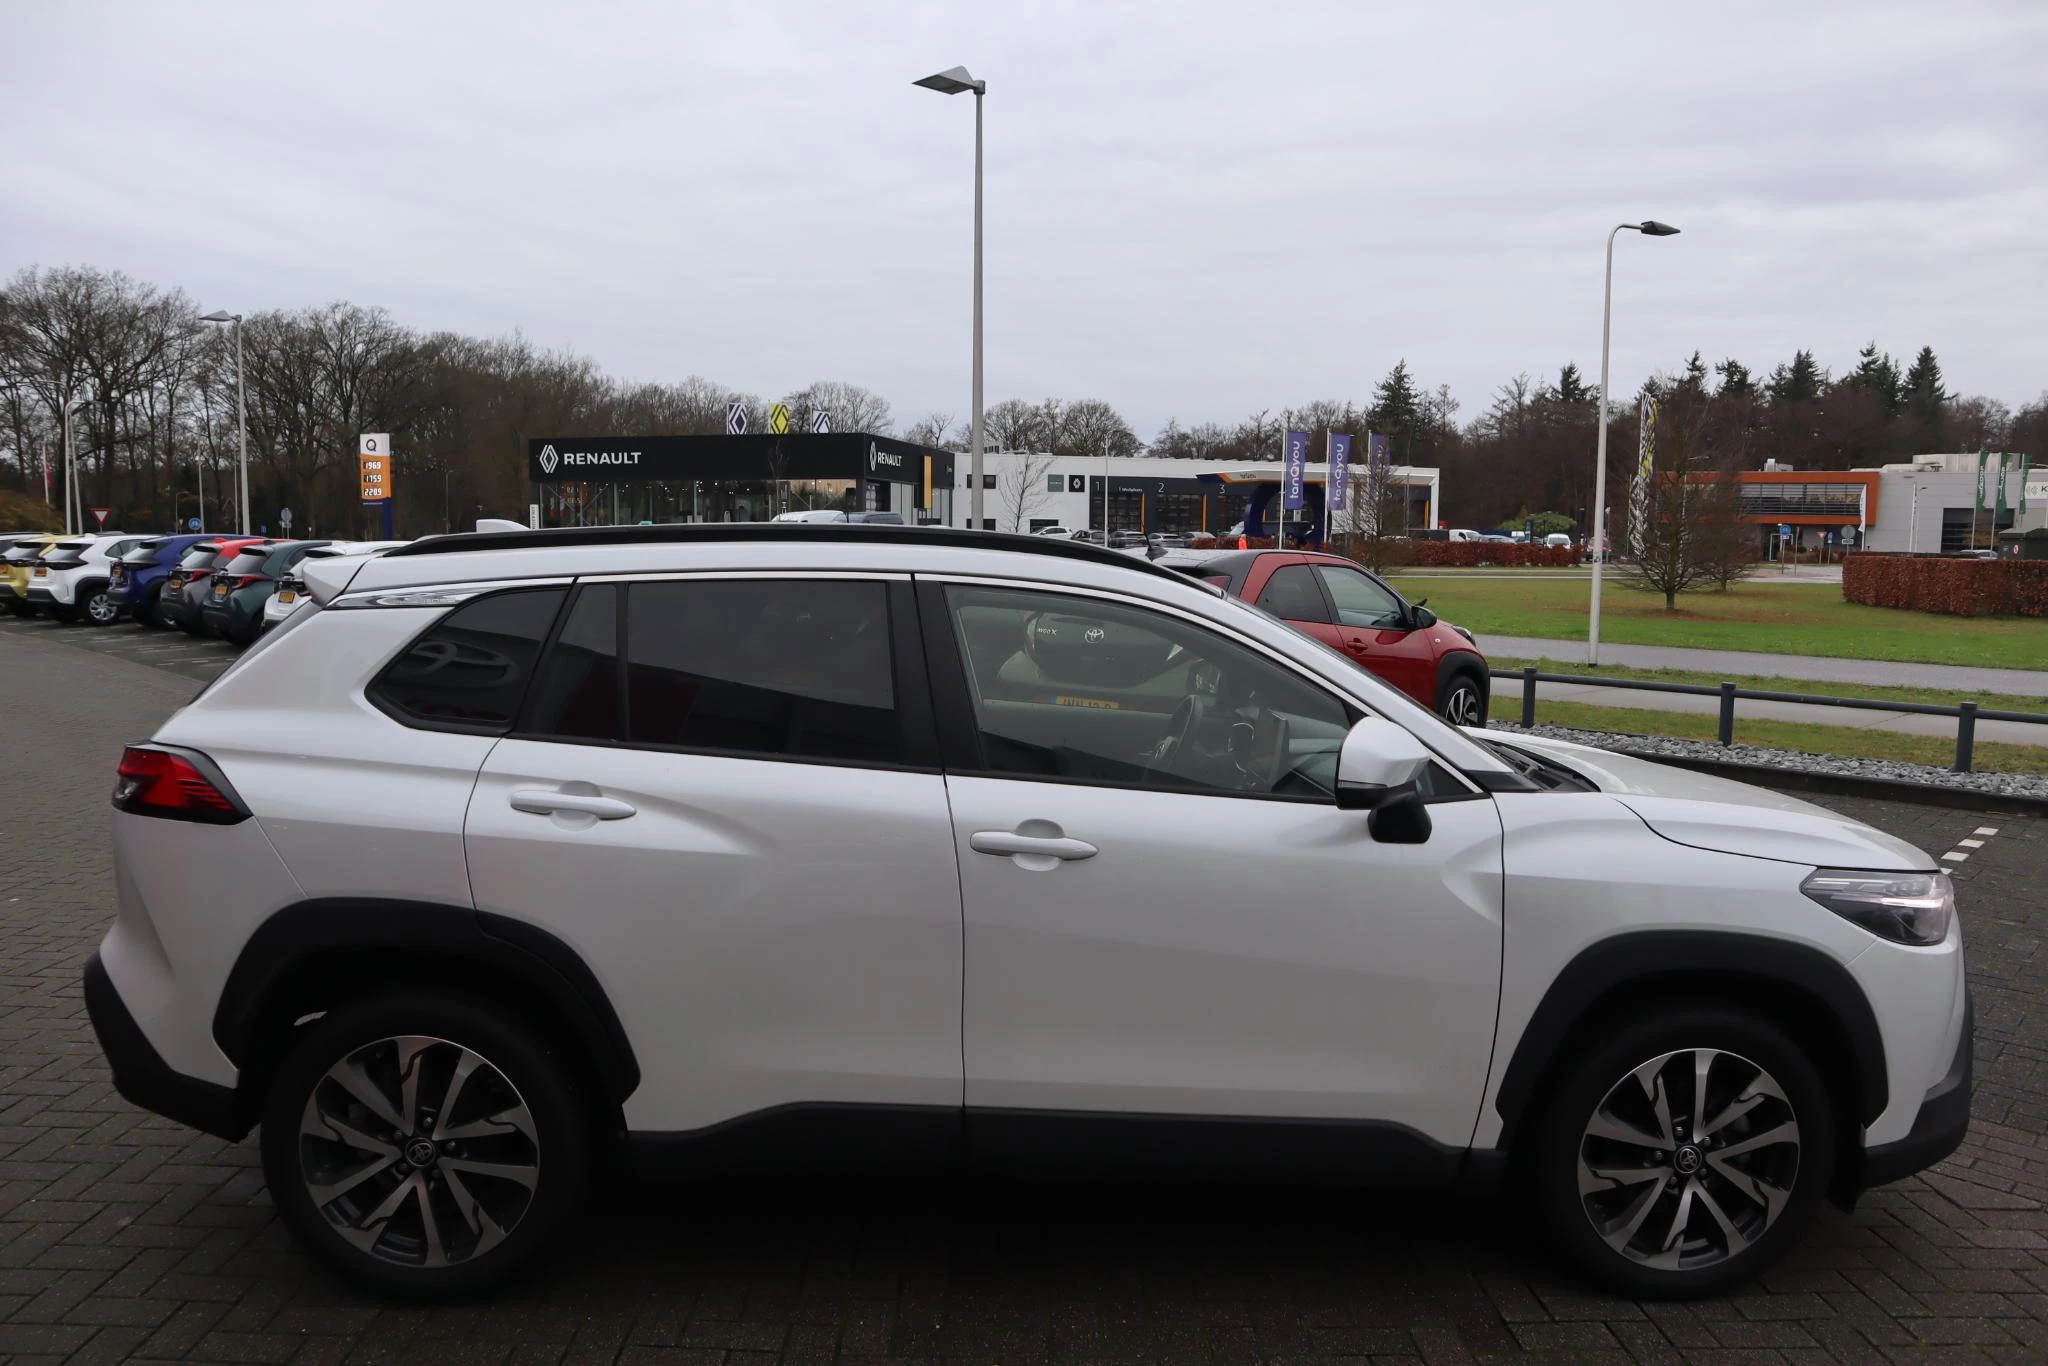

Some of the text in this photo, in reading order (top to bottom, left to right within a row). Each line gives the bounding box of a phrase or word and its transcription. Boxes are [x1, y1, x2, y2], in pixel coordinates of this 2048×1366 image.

[366, 438, 377, 452] Q
[563, 452, 642, 465] RENAULT
[877, 451, 902, 467] RENAULT
[1289, 441, 1300, 499] tanQyou
[1333, 443, 1344, 501] tanQyou
[1158, 482, 1165, 493] 2
[1219, 484, 1226, 494] 3
